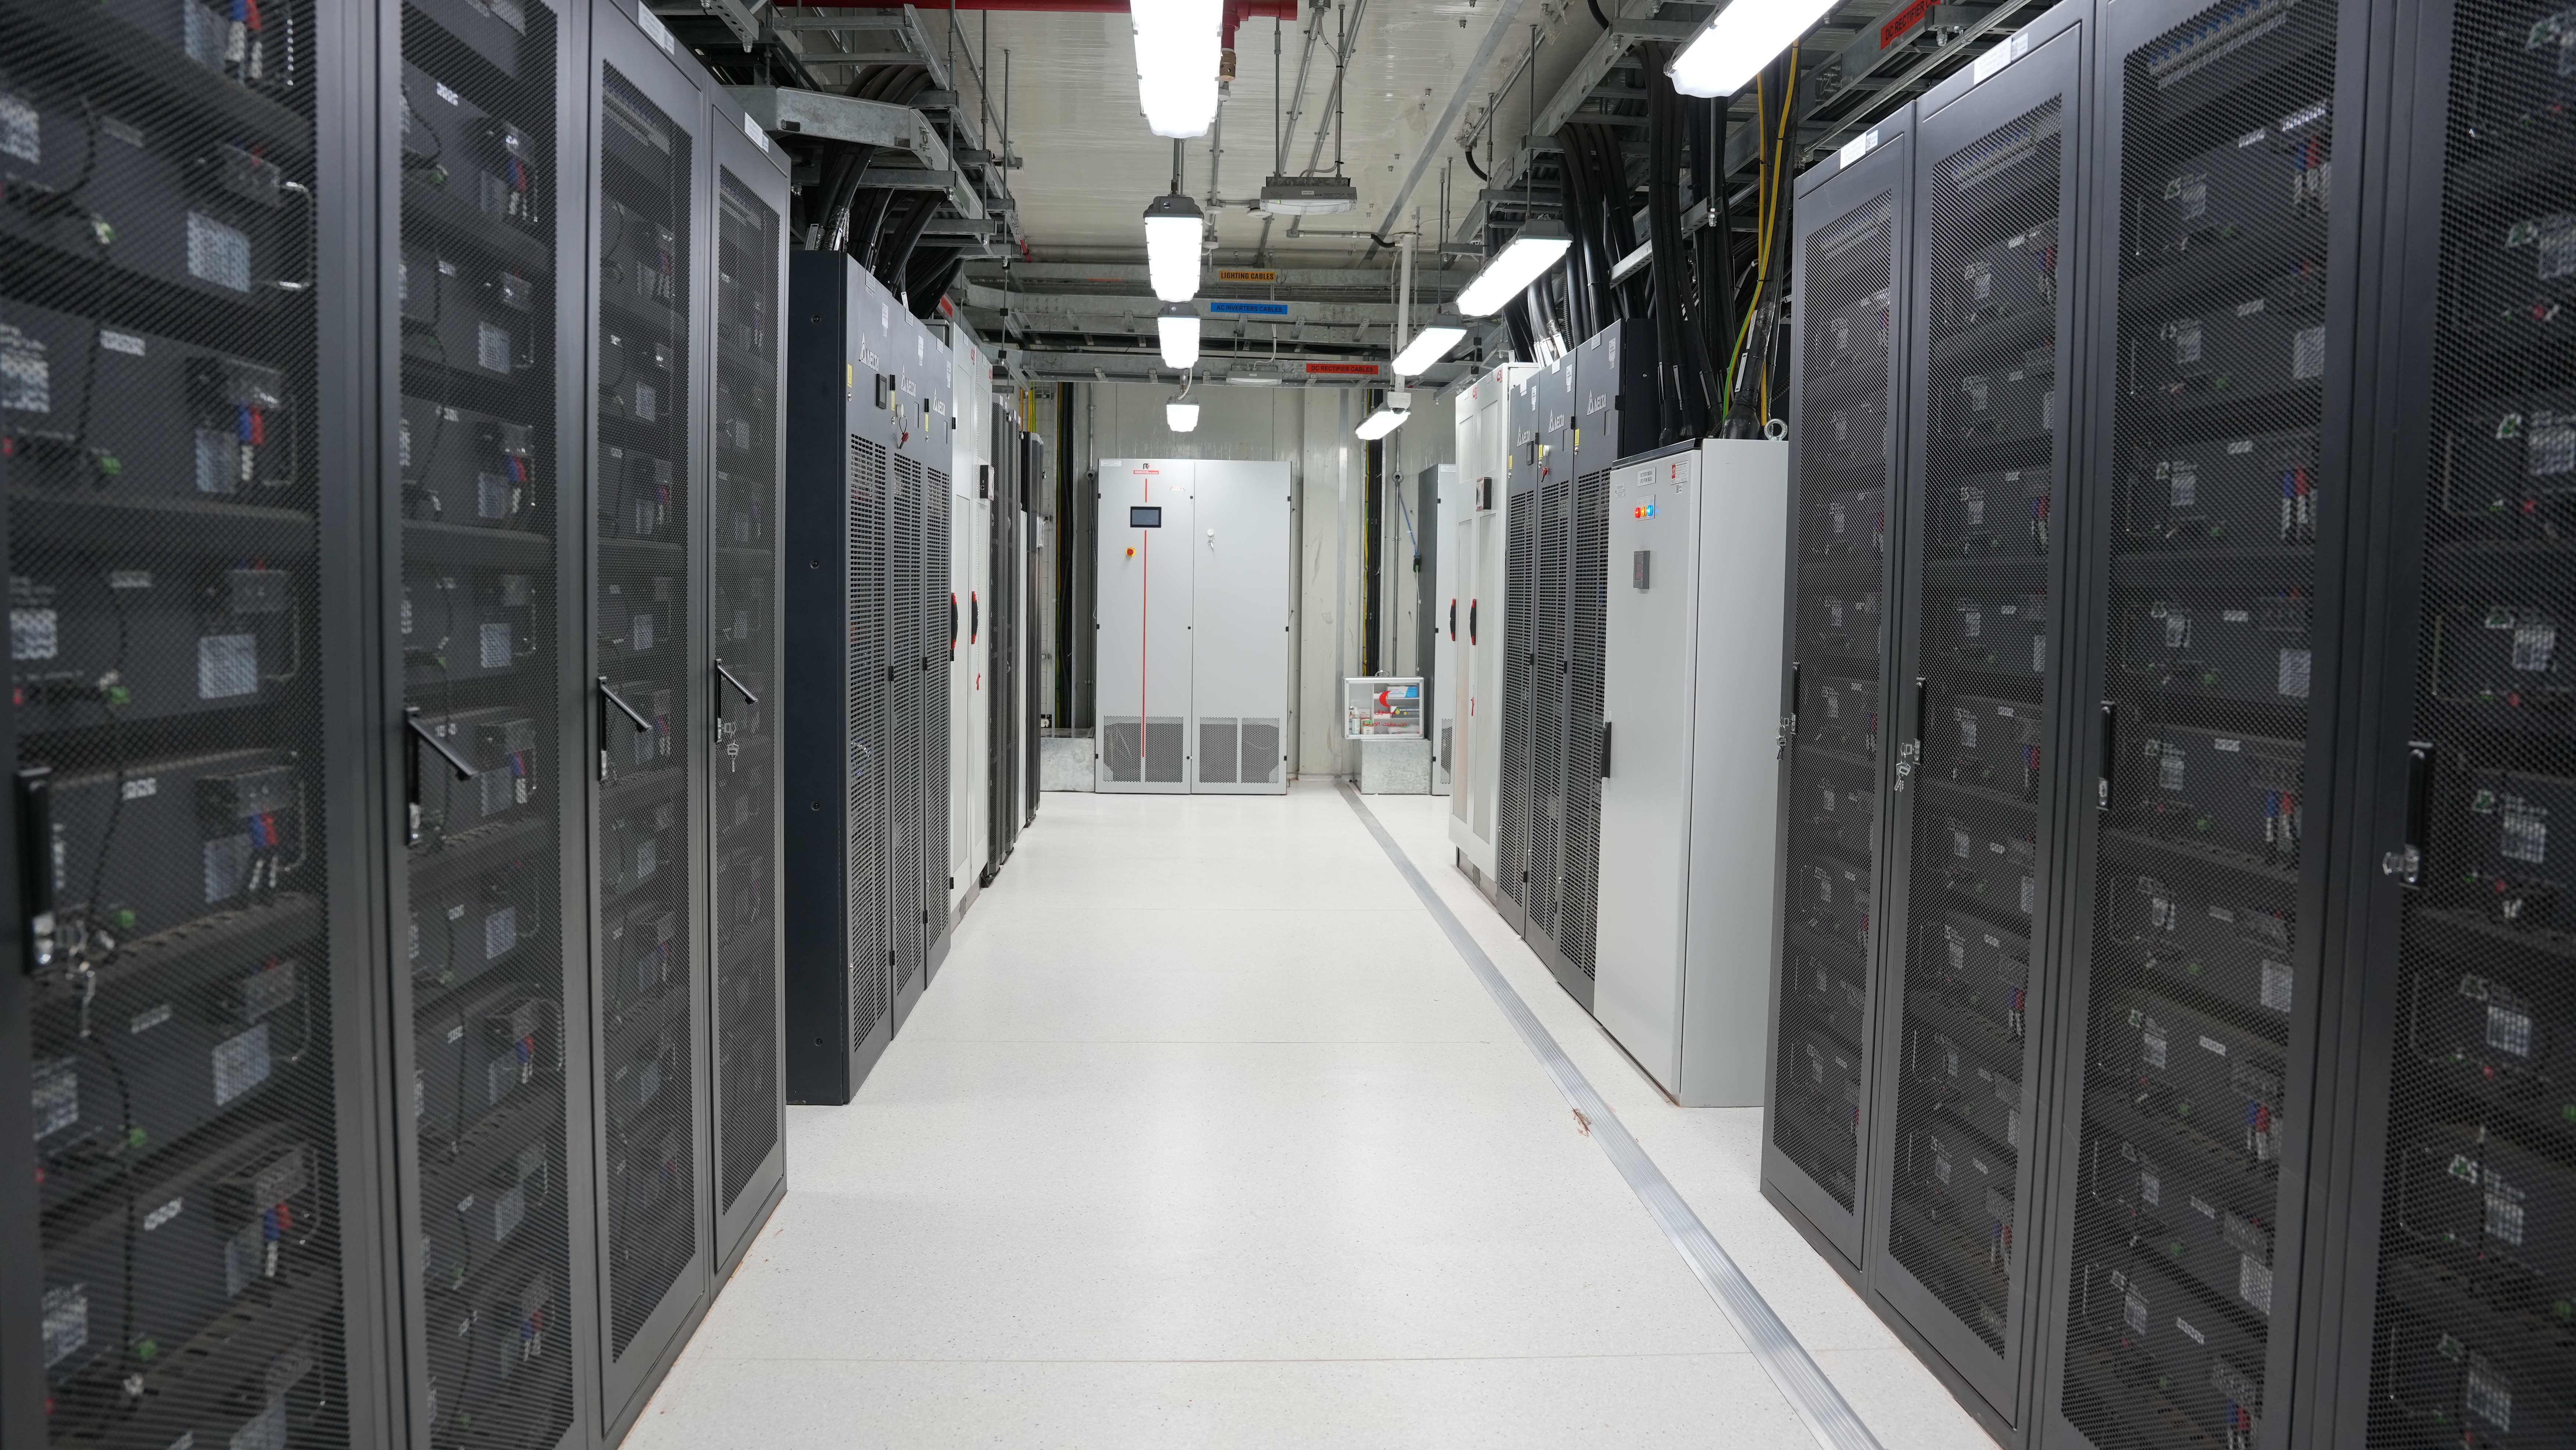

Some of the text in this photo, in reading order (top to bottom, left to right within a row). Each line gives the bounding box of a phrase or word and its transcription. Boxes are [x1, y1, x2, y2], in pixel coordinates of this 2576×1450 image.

[1886, 0, 1924, 41] DC RECTIFIER
[867, 349, 879, 372] DELTA
[906, 378, 916, 397] DELTA
[937, 400, 945, 416] DELTA
[1594, 393, 1606, 413] DELTA
[1554, 414, 1564, 430] DELTA
[1522, 430, 1530, 445] DELTA
